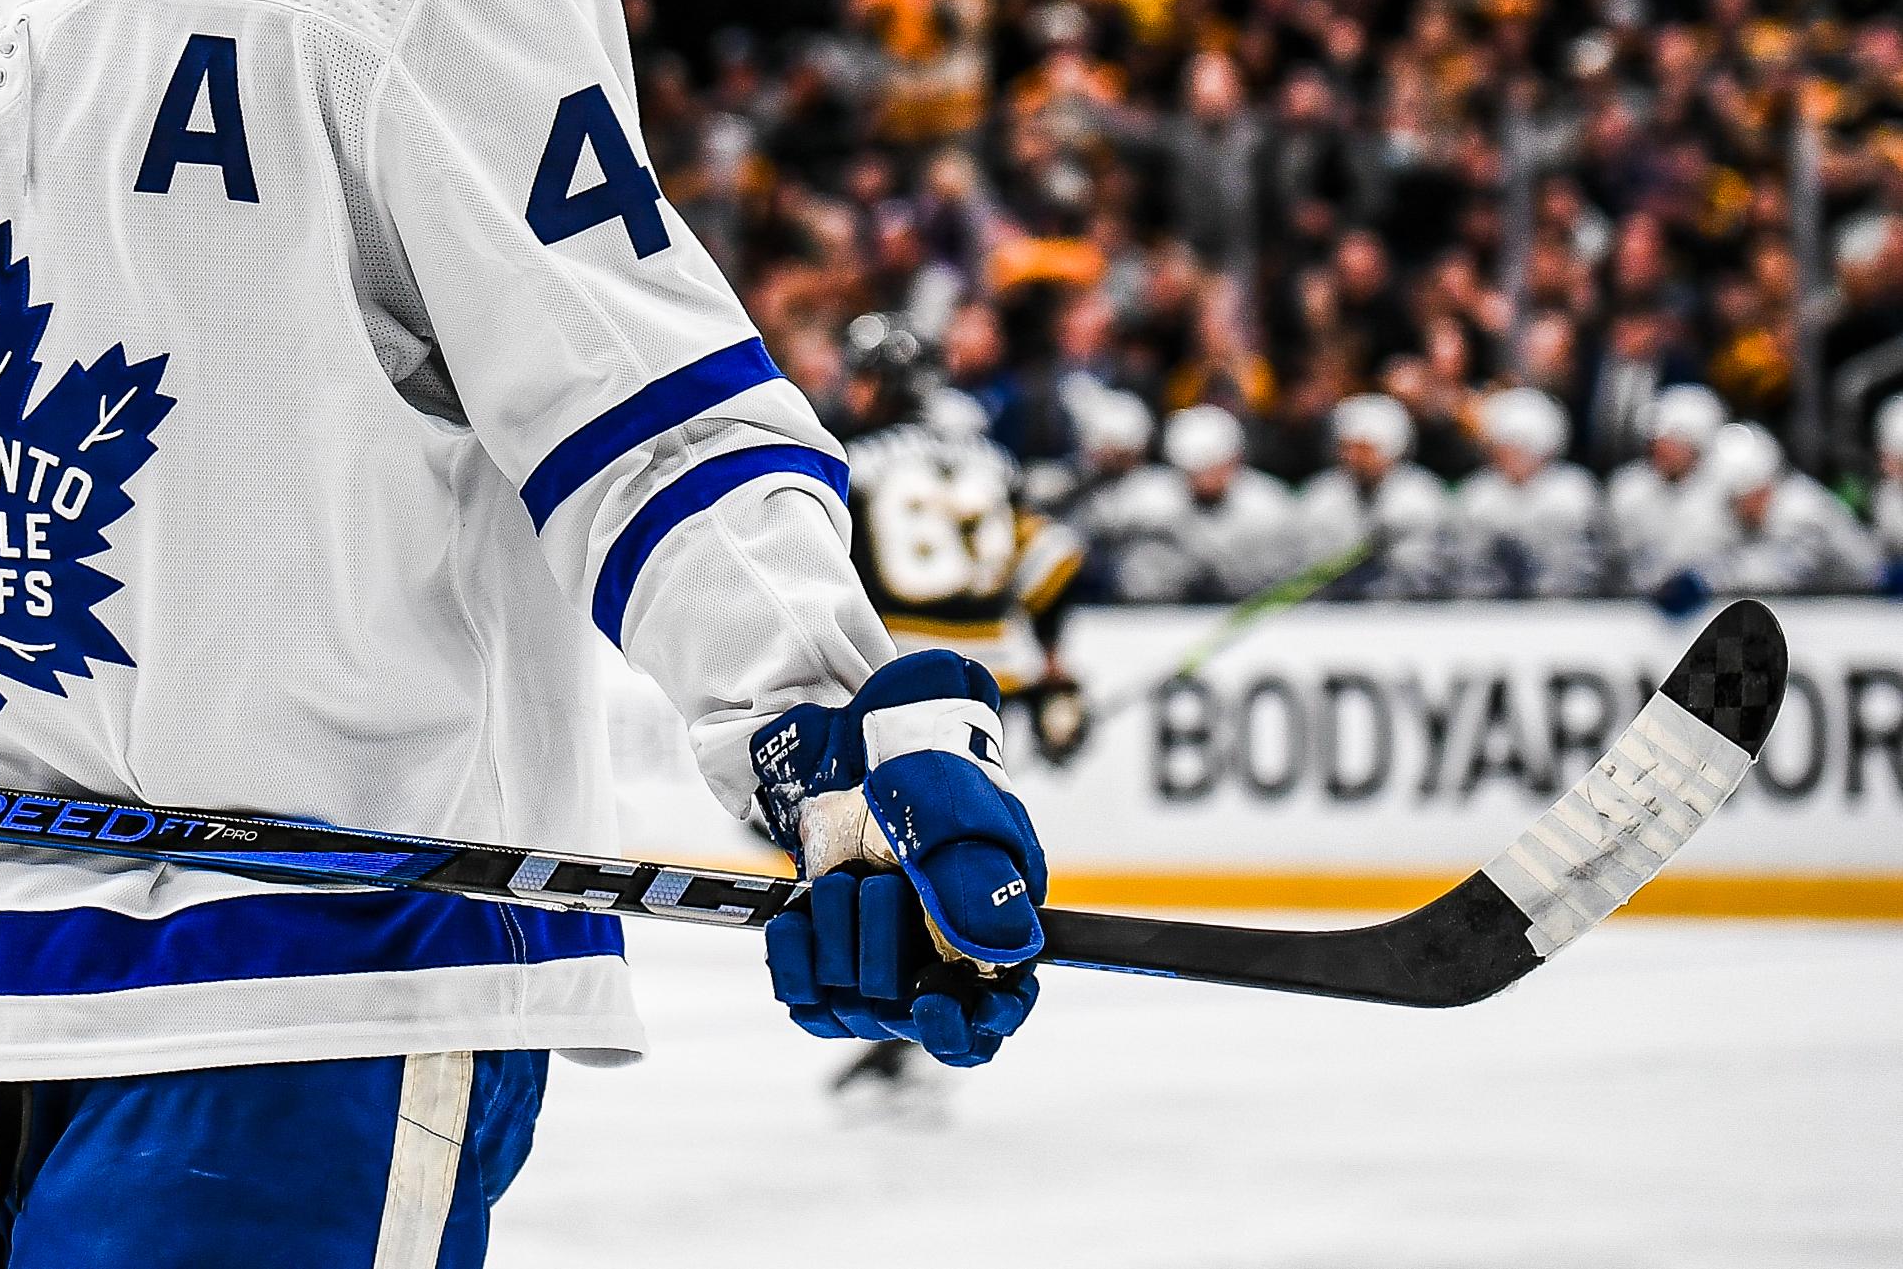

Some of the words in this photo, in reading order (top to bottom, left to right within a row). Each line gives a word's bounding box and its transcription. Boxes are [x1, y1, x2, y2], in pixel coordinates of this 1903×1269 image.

[133, 33, 261, 204] A
[525, 83, 672, 260] 4
[756, 722, 797, 765] CCM
[1152, 670, 1903, 802] BODYAROR
